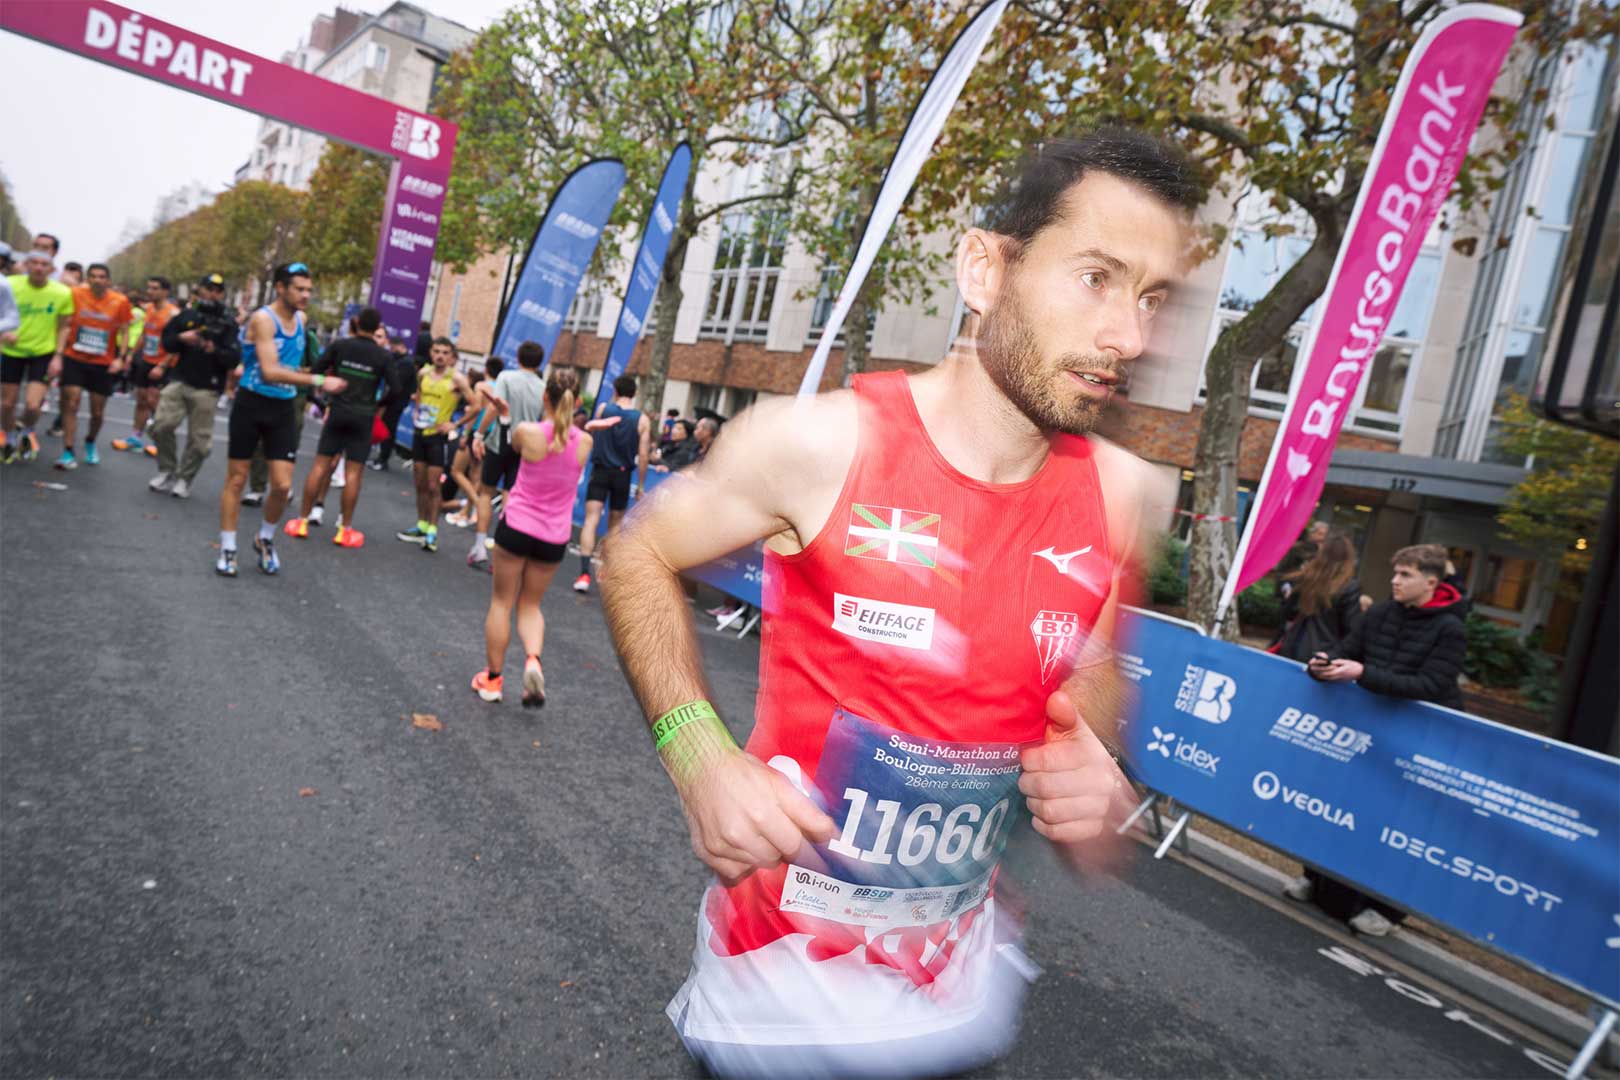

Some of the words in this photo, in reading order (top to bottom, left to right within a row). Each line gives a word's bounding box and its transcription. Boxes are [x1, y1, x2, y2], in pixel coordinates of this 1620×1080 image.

[84, 7, 253, 97] DÉPART
[858, 625, 907, 639] CONSTRUCTION
[859, 609, 926, 631] EIFFAGE
[1174, 664, 1197, 712] SEMI
[665, 702, 701, 730] ELITE
[1276, 706, 1358, 748] BBSD
[873, 747, 1021, 776] Boulogne-Billancourt
[888, 734, 1001, 760] Semi-Marathon
[1003, 746, 1019, 759] de
[1174, 736, 1221, 773] idex
[905, 775, 949, 789] 28ème
[951, 779, 991, 791] édition
[1282, 786, 1355, 831] VEOLIA
[827, 787, 1009, 867] 11660
[1380, 826, 1563, 912] IDEC.SPORT
[812, 876, 840, 894] i-run
[853, 887, 888, 897] BBSD
